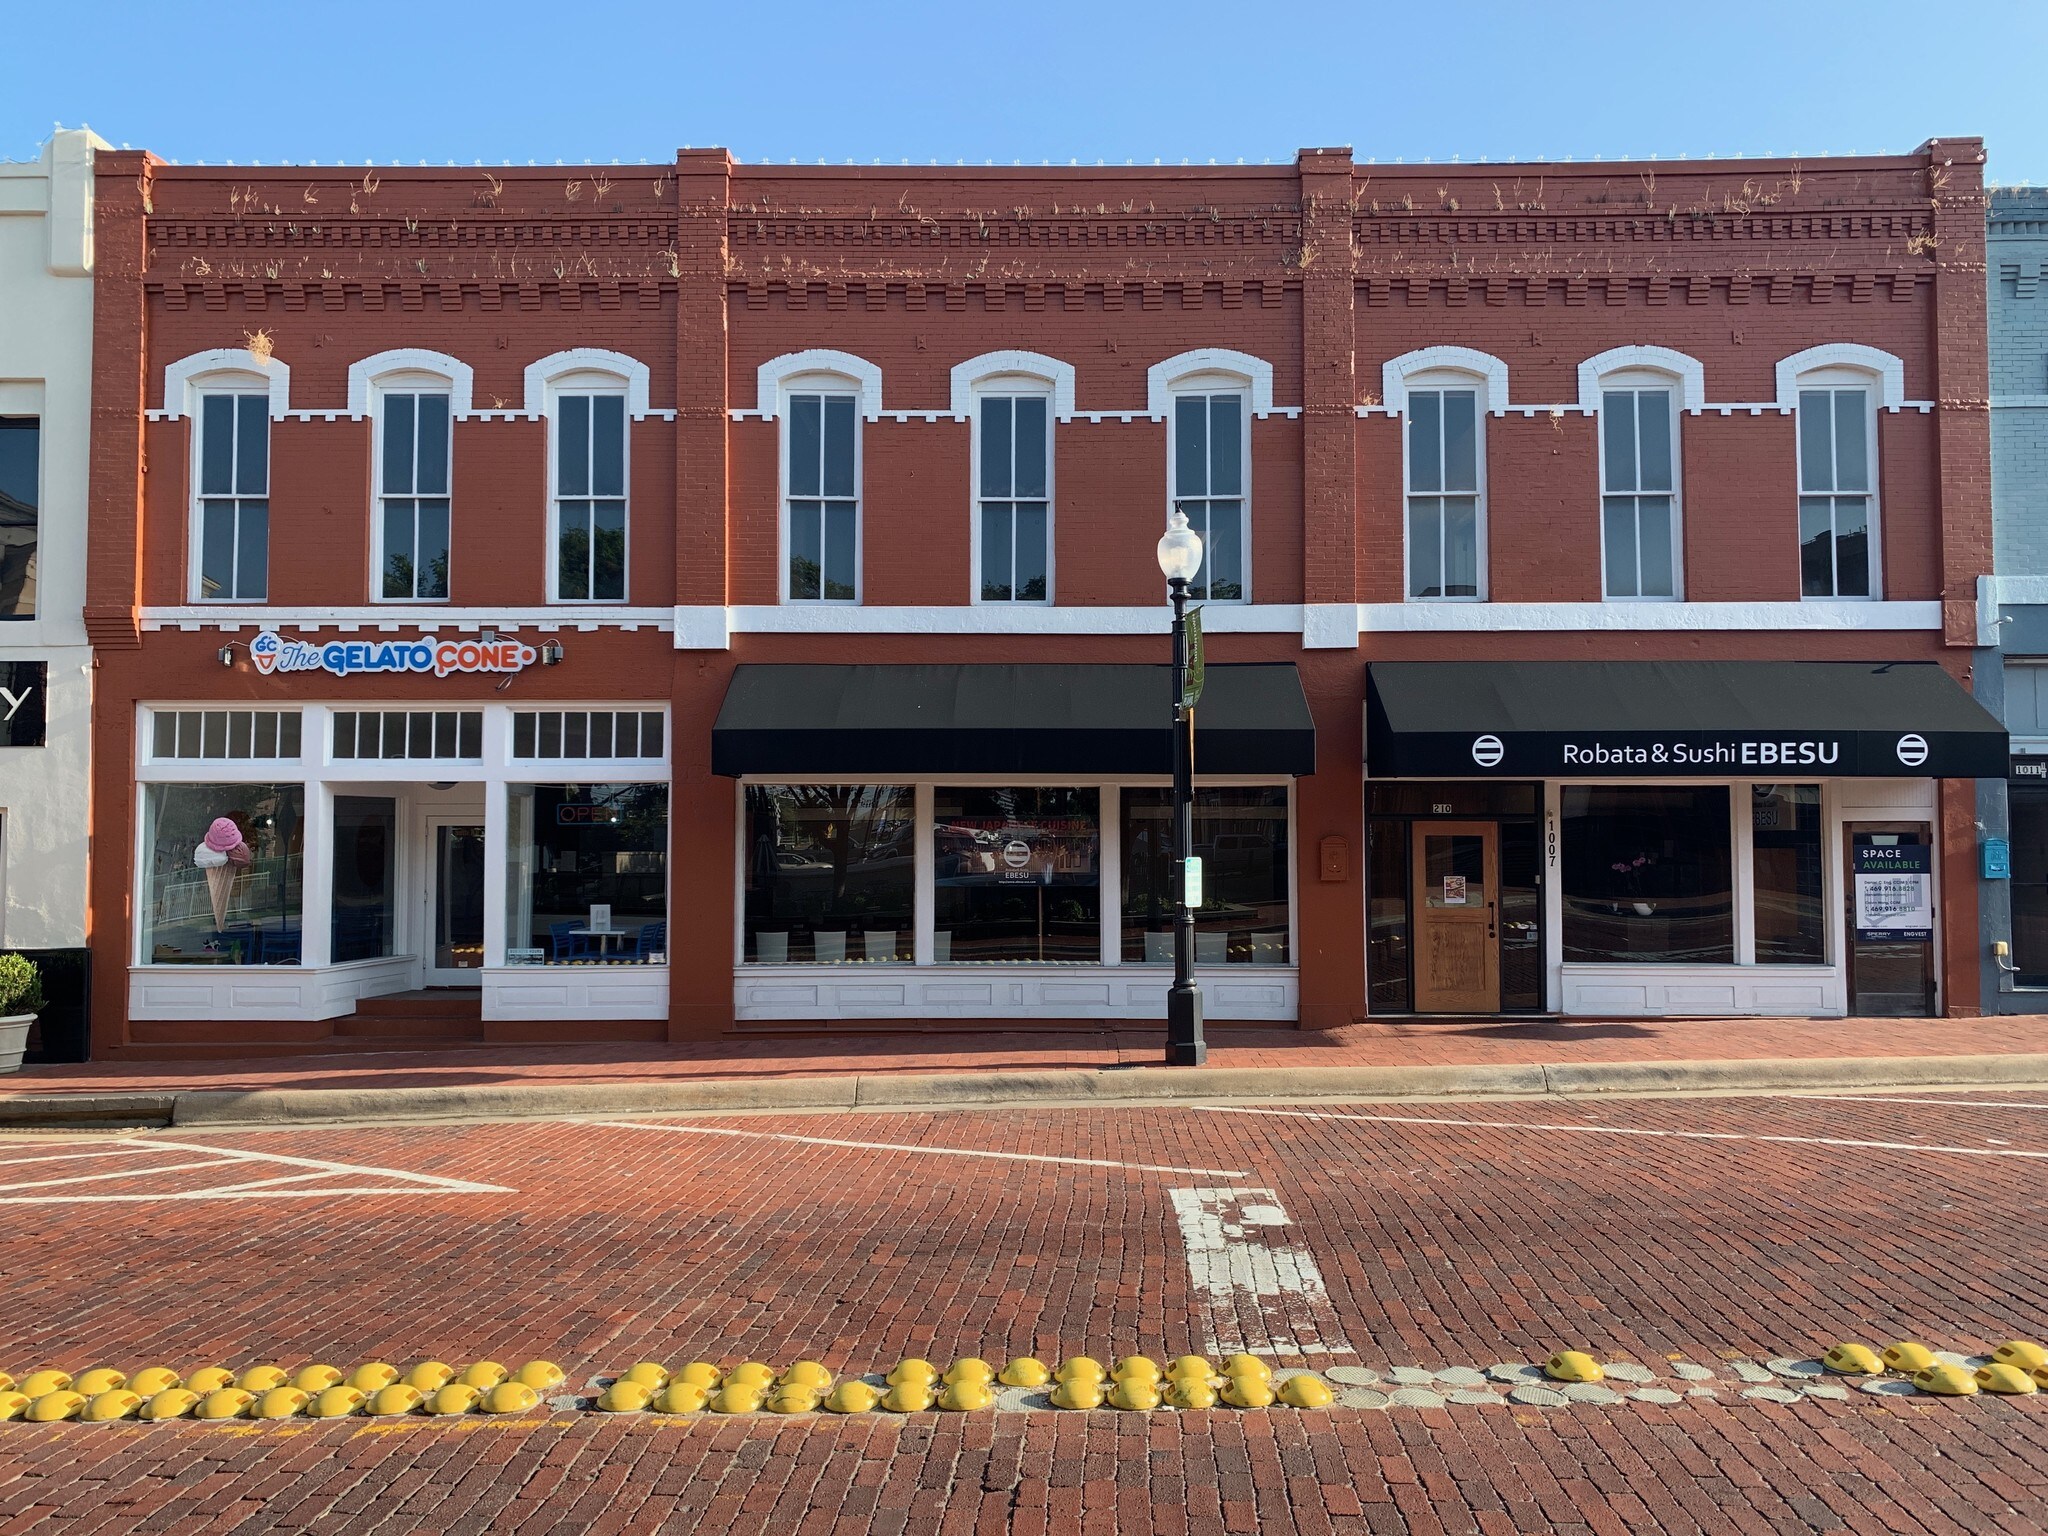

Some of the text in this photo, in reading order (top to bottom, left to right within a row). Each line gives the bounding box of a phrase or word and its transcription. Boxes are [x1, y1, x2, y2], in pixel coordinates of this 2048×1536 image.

[280, 645, 519, 674] The GELATO CONE
[1563, 742, 1839, 764] Robata & Sushi EBESU
[560, 807, 618, 821] OPEN
[1433, 804, 1452, 813] 210
[1548, 820, 1556, 867] 1007
[1863, 849, 1901, 858] SPACE
[1863, 861, 1920, 869] AVAILABLE
